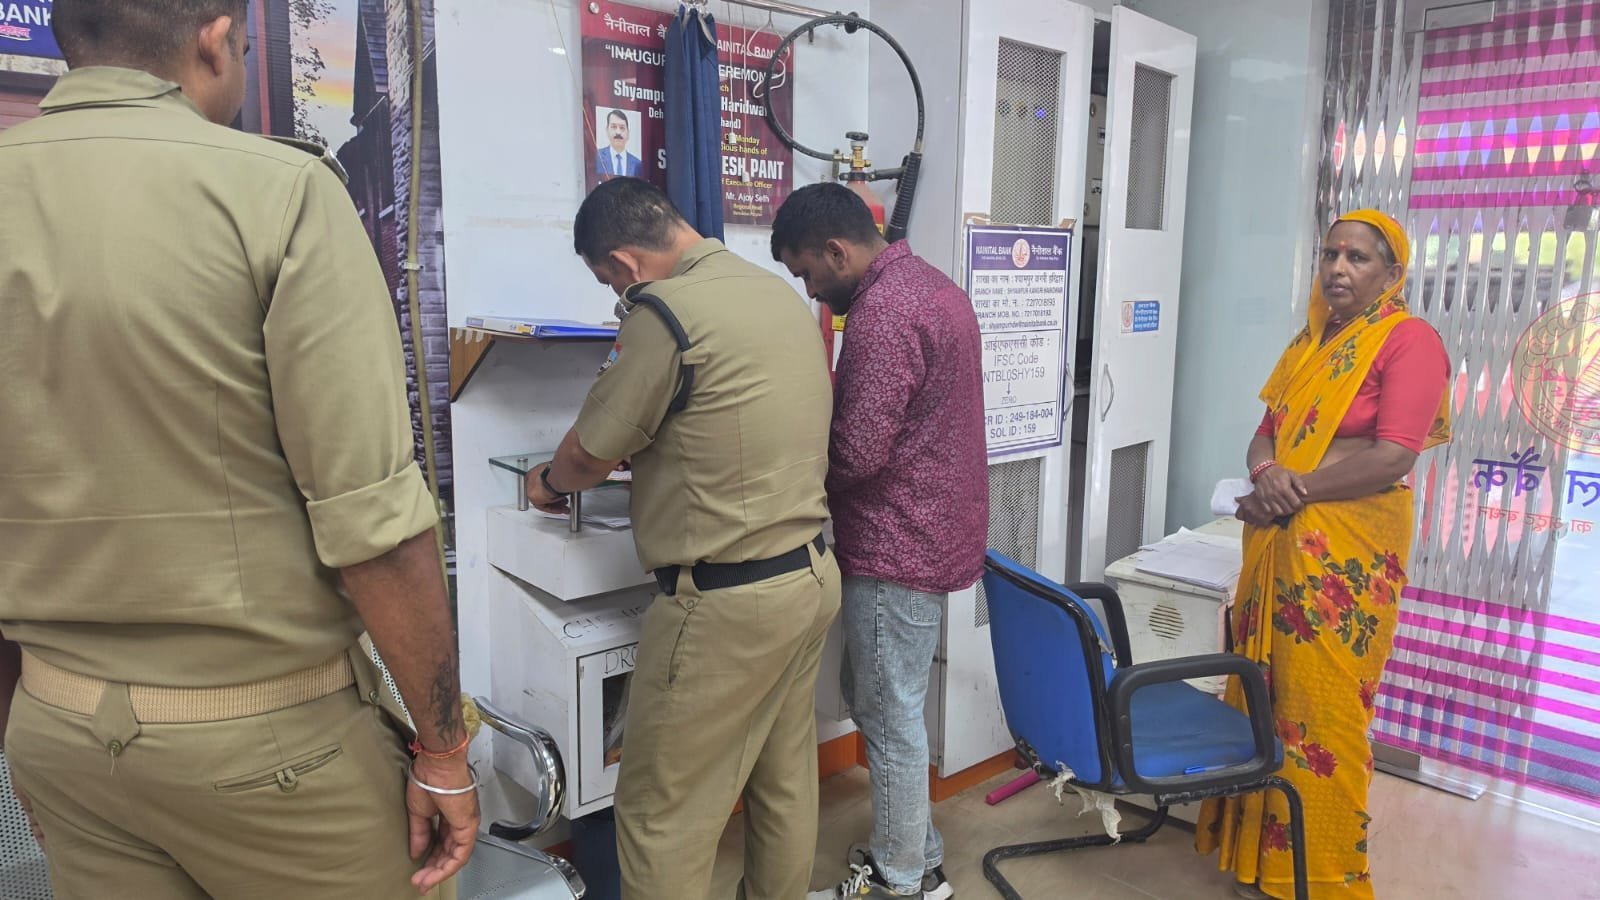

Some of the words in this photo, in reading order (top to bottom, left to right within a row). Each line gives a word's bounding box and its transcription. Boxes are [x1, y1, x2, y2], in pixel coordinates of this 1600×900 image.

[603, 12, 651, 37] नैनीताल
[717, 40, 753, 57] AINITAL
[755, 46, 775, 59] BAN
[718, 64, 767, 82] EREMON
[739, 145, 759, 154] hands
[721, 155, 746, 177] ESH
[750, 158, 785, 180] PANT
[976, 246, 998, 255] NAINITAL
[998, 246, 1012, 255] BANK
[1031, 244, 1052, 256] नैनीताल
[1052, 244, 1063, 256] बैंक
[1030, 335, 1045, 346] कोड
[994, 354, 1015, 366] IFSC
[1017, 352, 1039, 364] Code
[1001, 396, 1017, 404] ZERO
[995, 414, 1004, 425] ID
[1010, 408, 1053, 423] 249-184-004
[990, 428, 1007, 438] SOL
[1009, 426, 1017, 436] ID
[1024, 423, 1036, 433] 159
